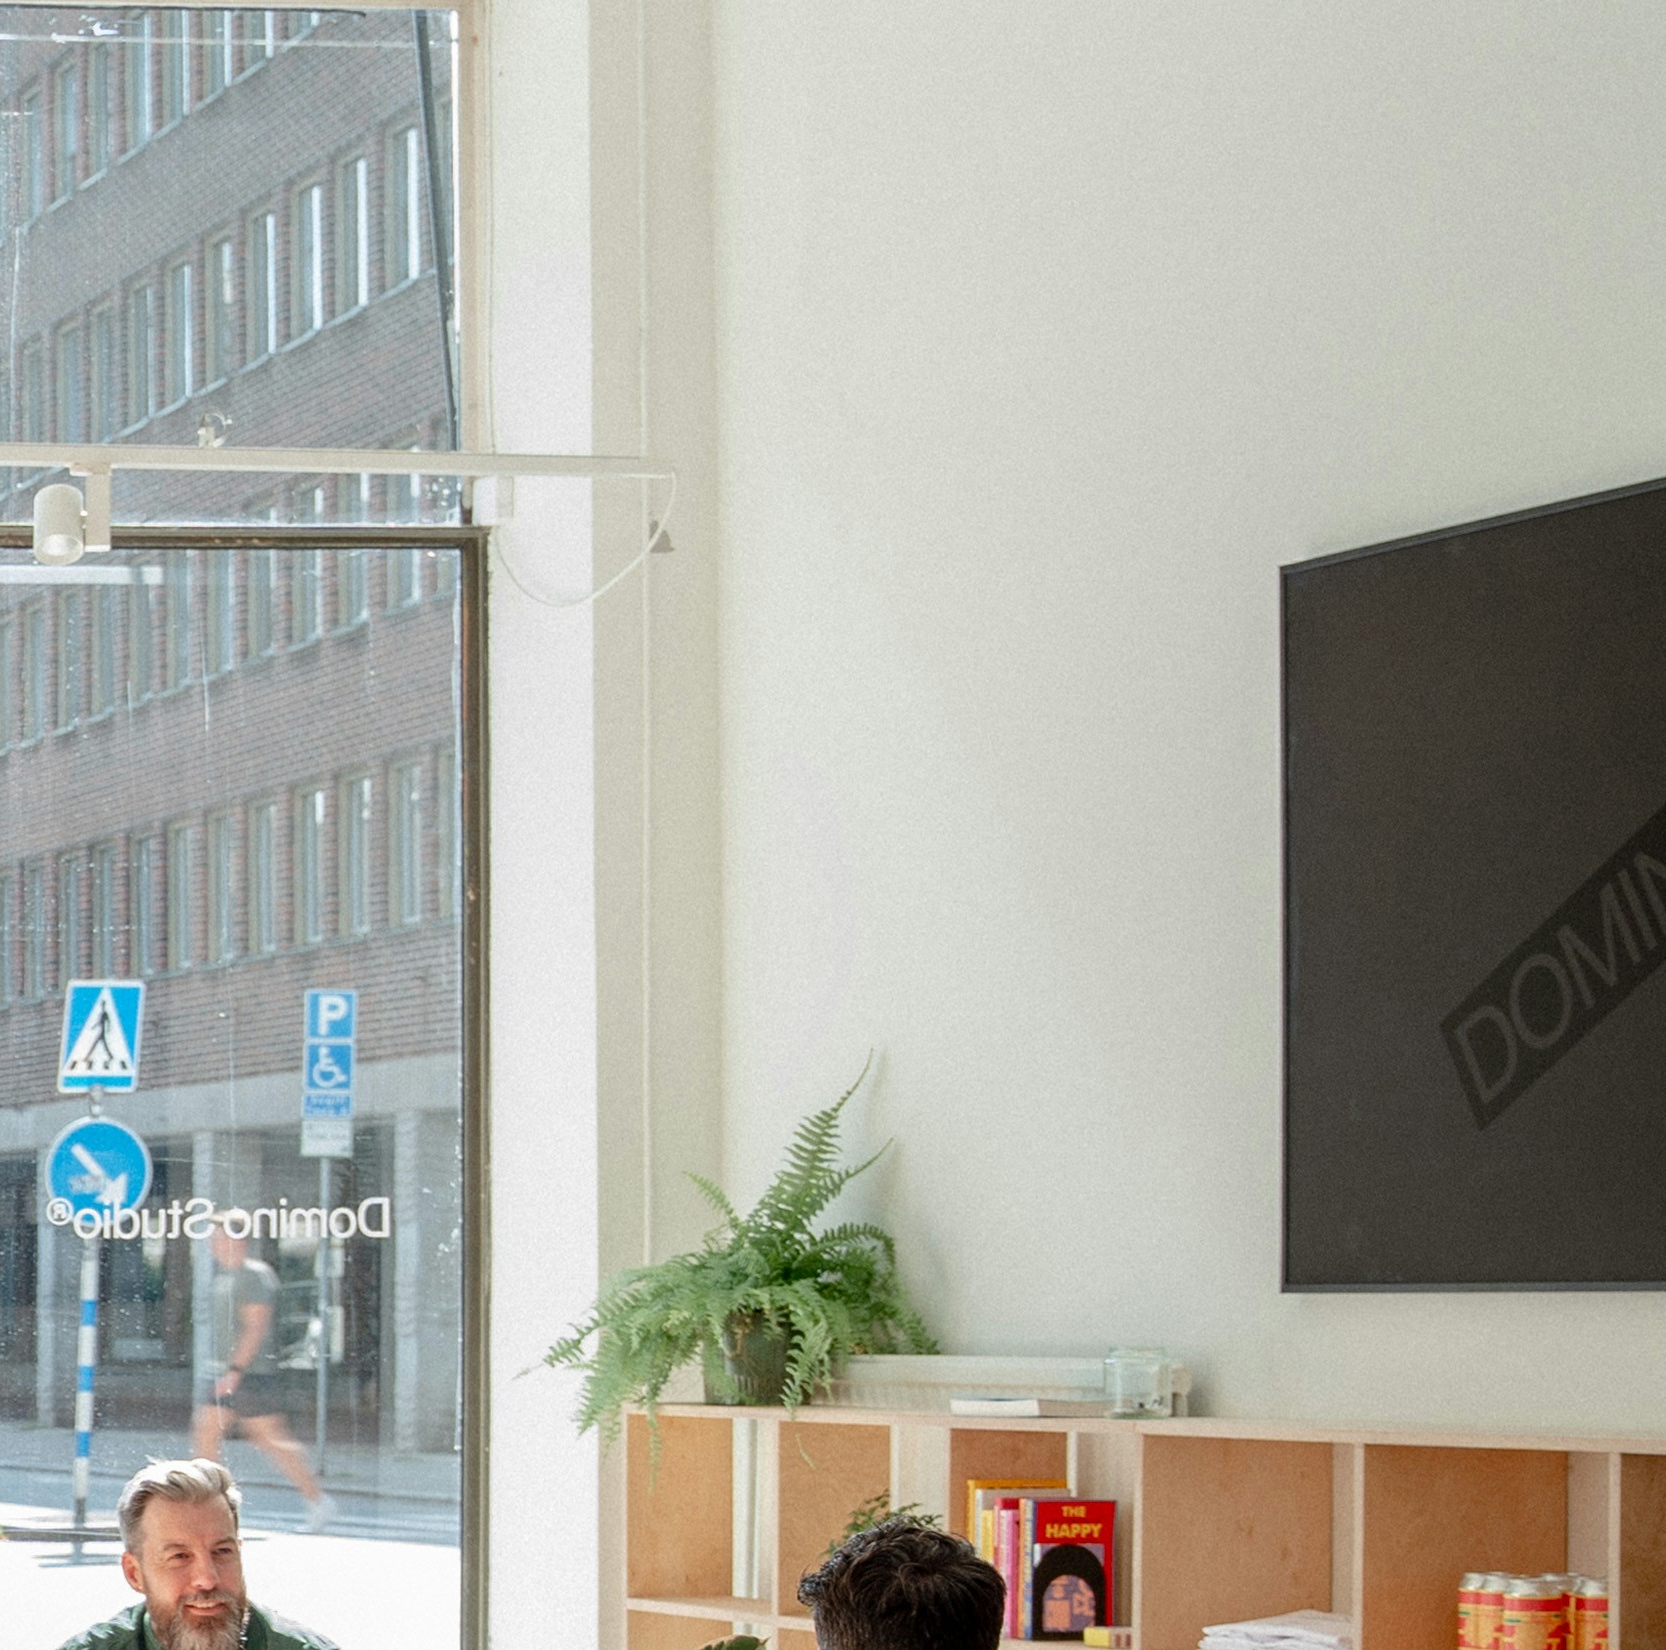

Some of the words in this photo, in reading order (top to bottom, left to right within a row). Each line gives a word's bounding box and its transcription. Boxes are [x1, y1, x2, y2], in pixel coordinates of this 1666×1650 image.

[318, 994, 349, 1036] P
[1061, 1506, 1087, 1518] THE
[1045, 1523, 1102, 1539] HAPPY
